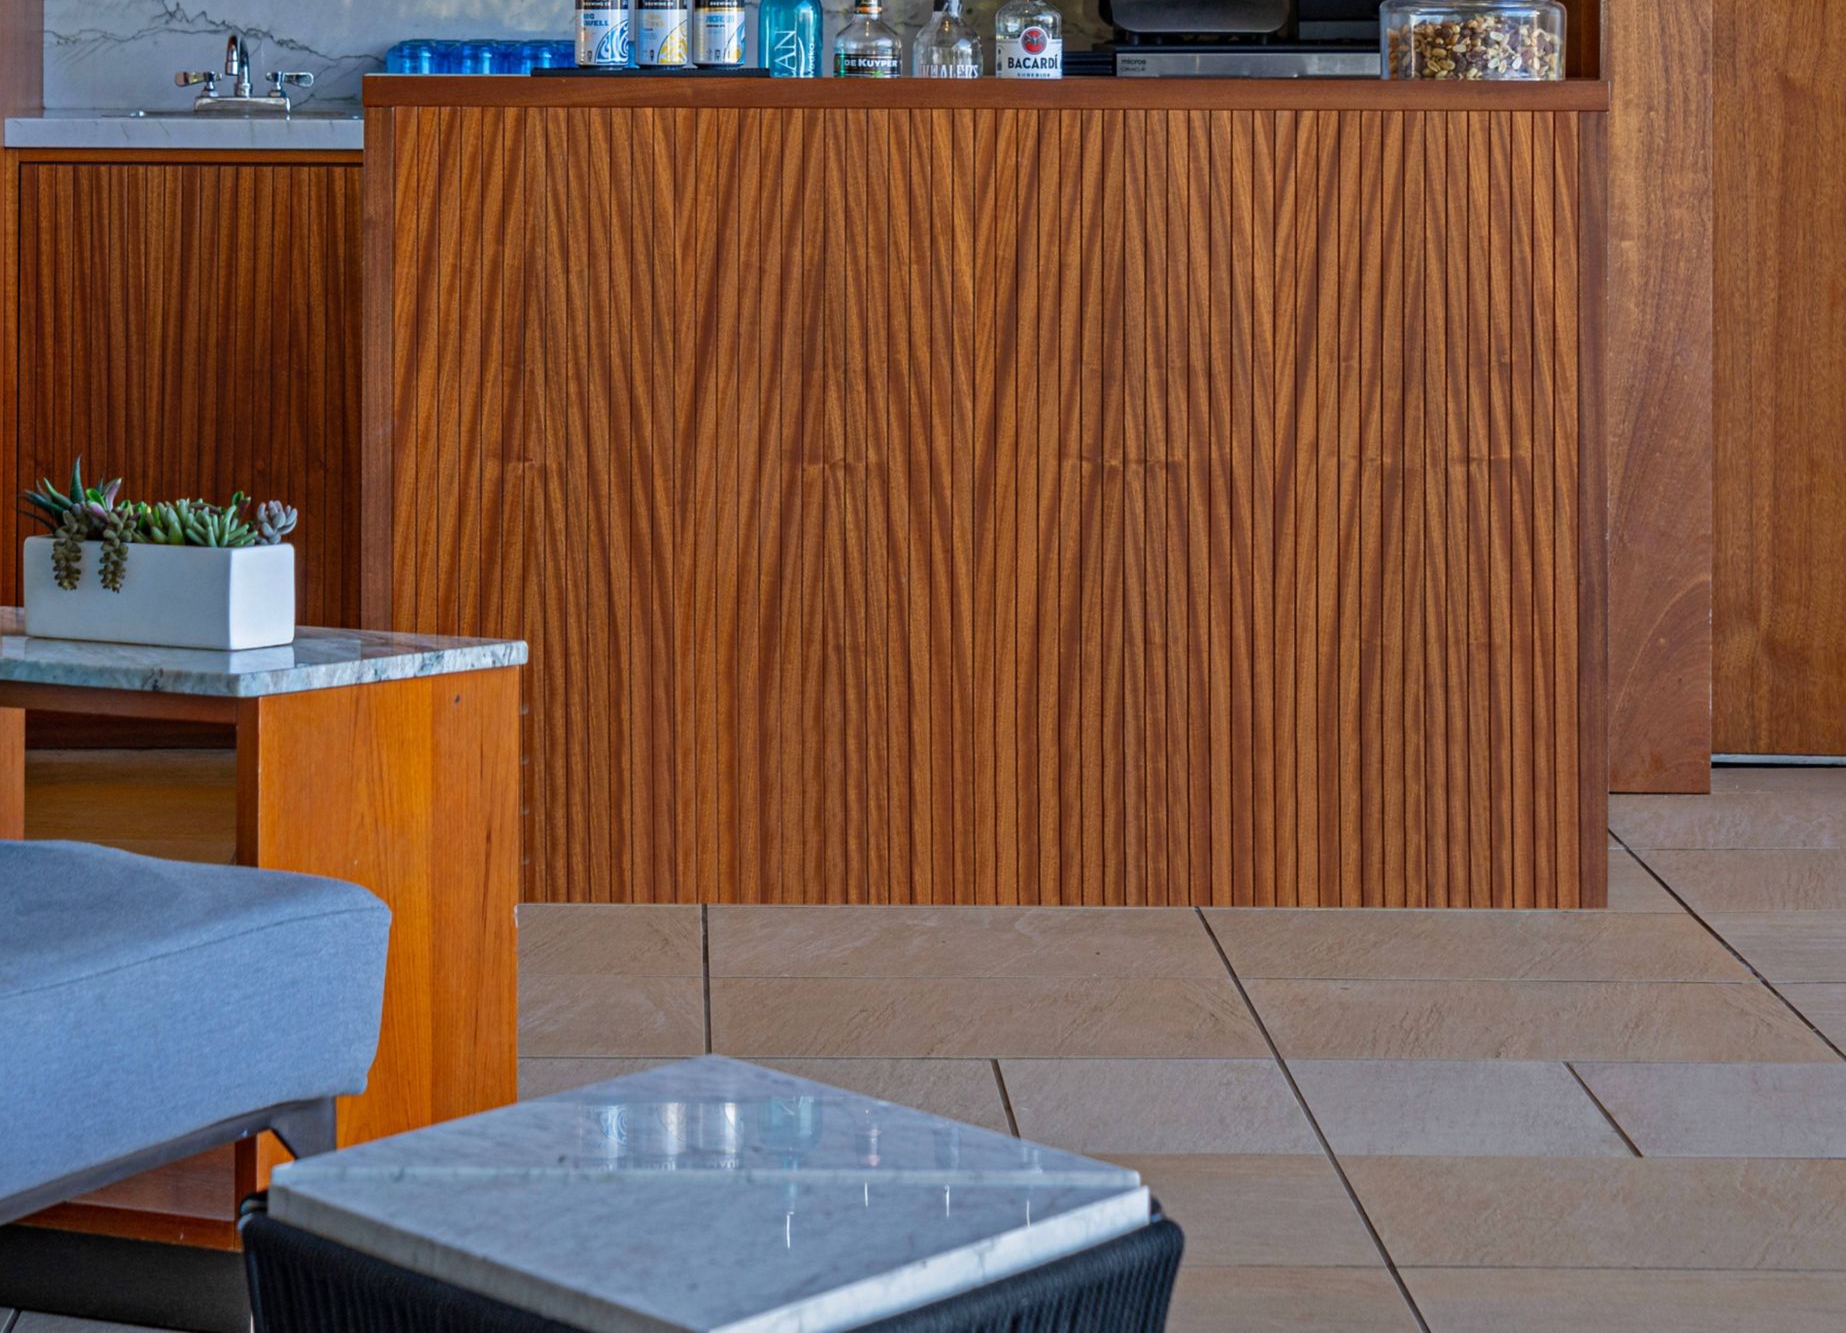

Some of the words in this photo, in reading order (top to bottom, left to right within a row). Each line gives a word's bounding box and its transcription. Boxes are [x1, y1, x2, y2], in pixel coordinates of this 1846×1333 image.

[844, 58, 857, 67] DE
[858, 58, 898, 67] KUYPER
[1007, 54, 1058, 69] BACARDÍ
